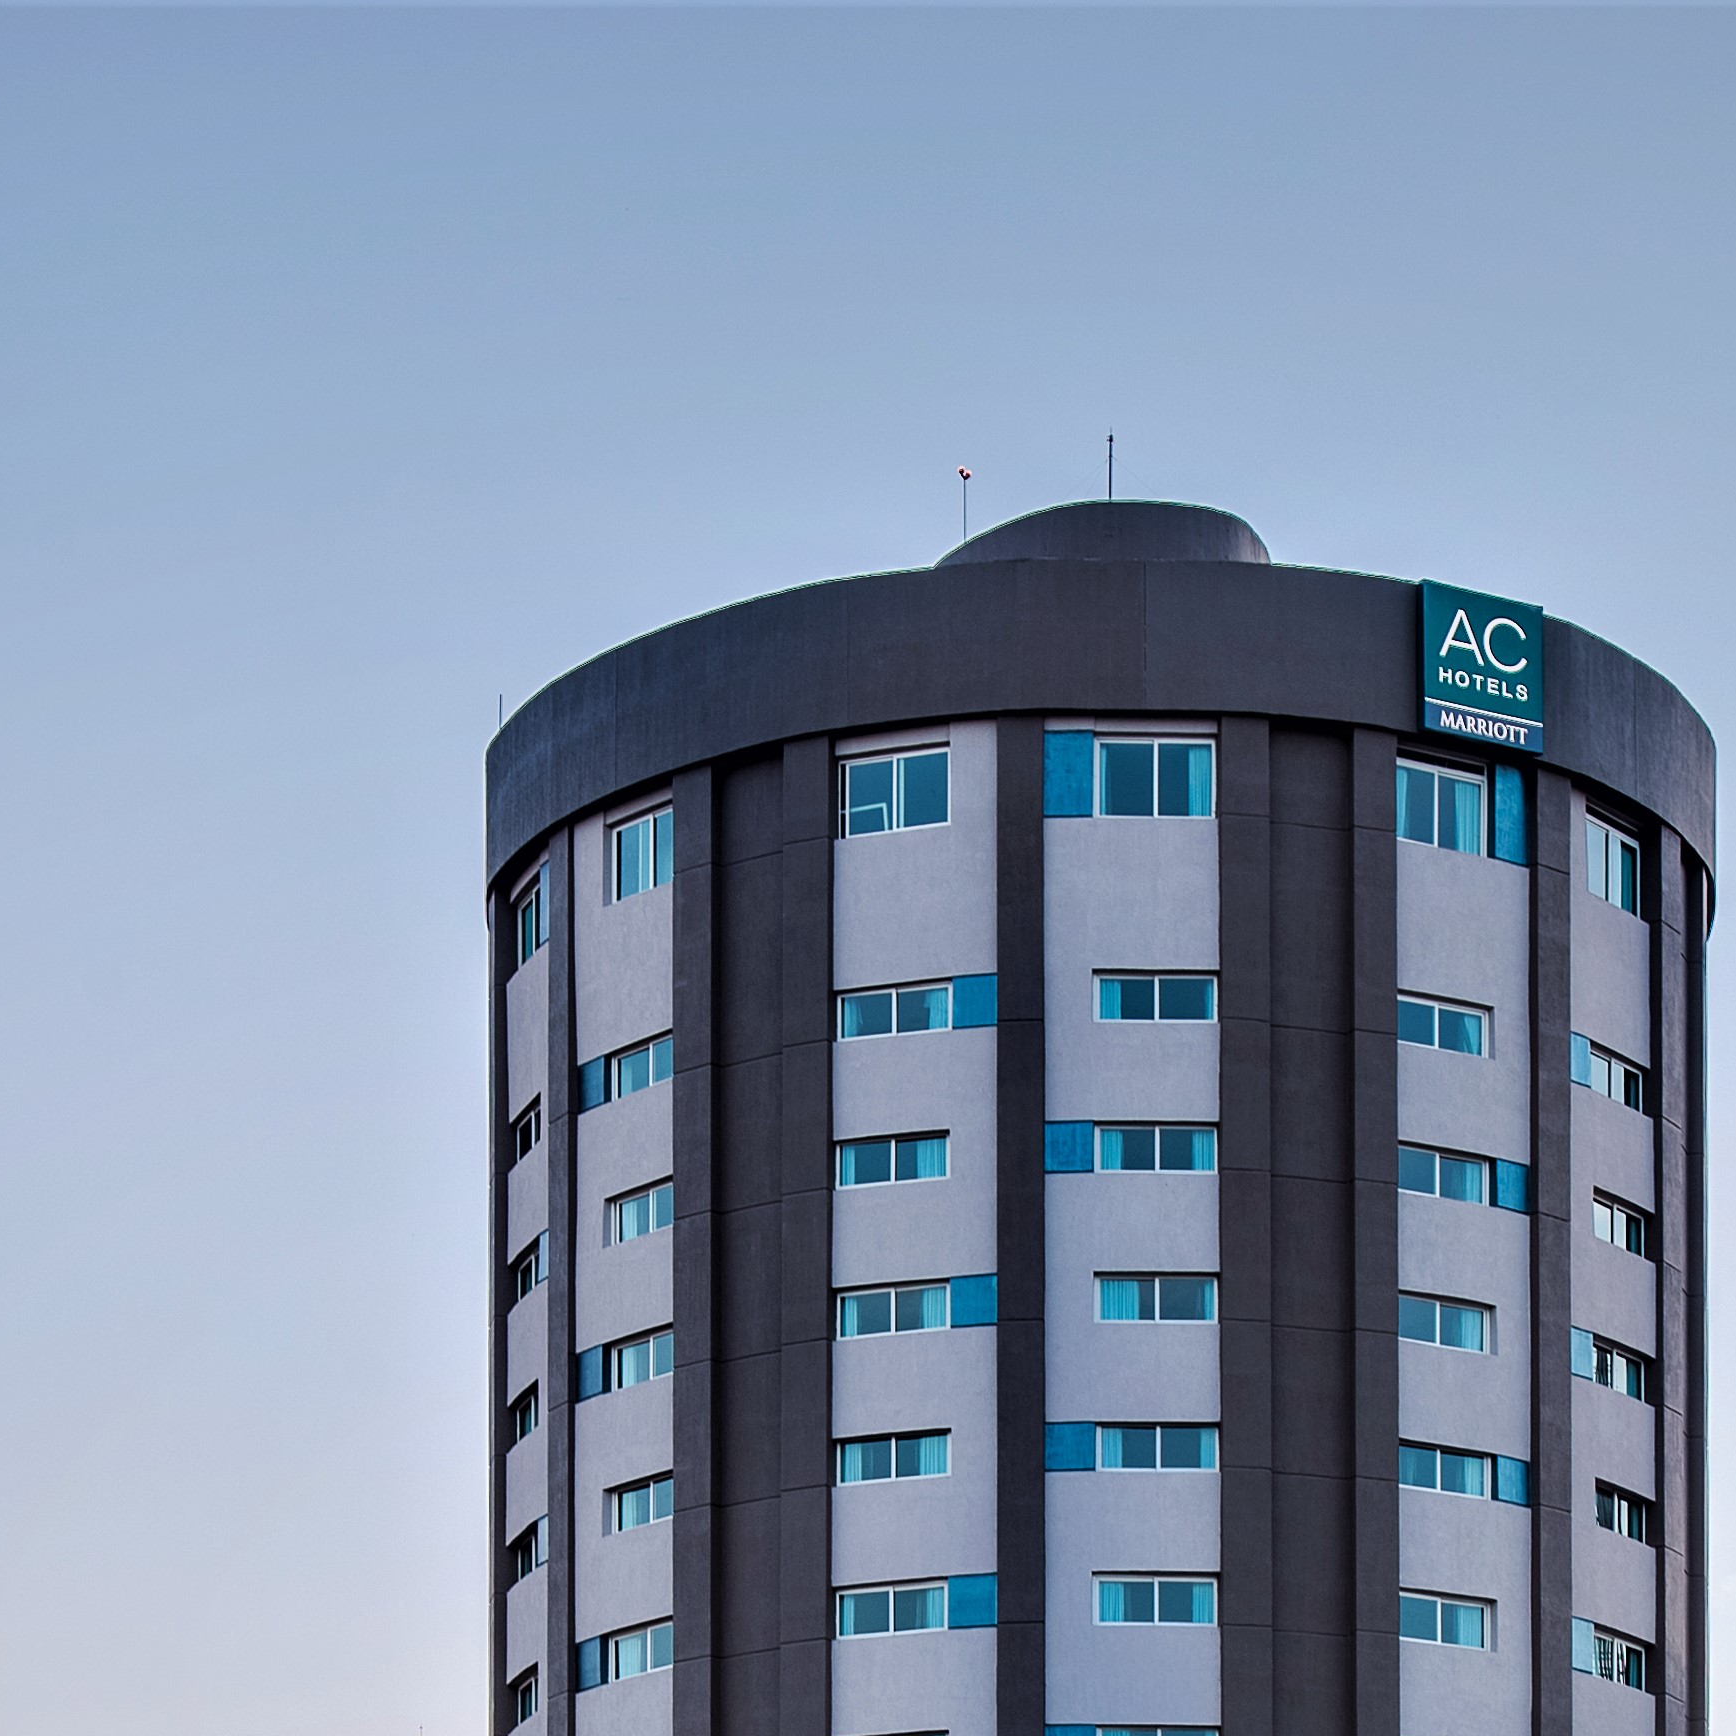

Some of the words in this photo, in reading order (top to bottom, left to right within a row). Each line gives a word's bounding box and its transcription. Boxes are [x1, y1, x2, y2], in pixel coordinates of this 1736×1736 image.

[1439, 608, 1528, 674] AC
[1438, 666, 1529, 702] HOTELS
[1439, 710, 1529, 745] MARRIOTT
